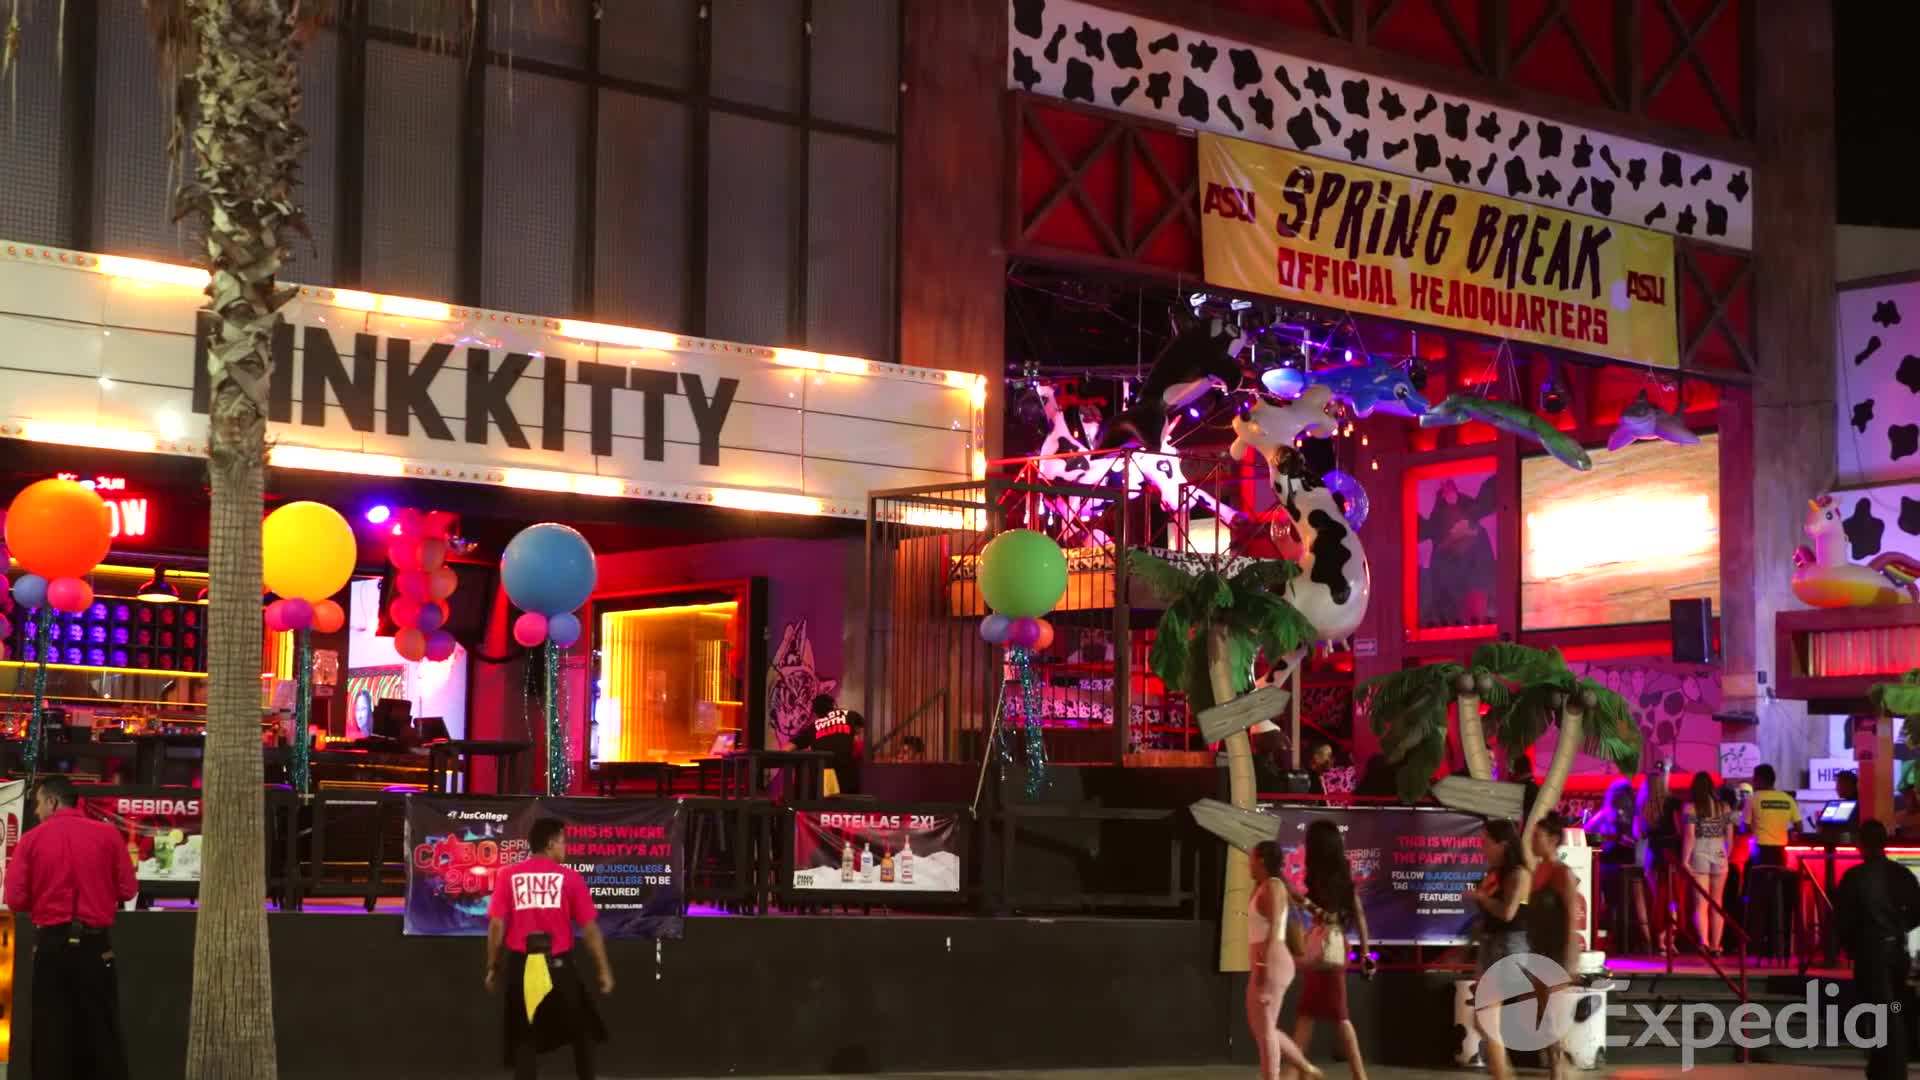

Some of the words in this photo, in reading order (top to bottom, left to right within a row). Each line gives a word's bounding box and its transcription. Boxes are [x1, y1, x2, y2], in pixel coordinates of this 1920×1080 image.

[1203, 182, 1256, 224] ASU
[1466, 204, 1612, 300] BREAK
[1277, 246, 1398, 306] OFFICIAL
[1410, 272, 1609, 345] HEADQUARTERS
[1626, 270, 1666, 305] ASU
[117, 798, 200, 816] BEBIDAS
[458, 811, 509, 822] JusCollege
[820, 814, 900, 830] BOTELLAS
[566, 825, 598, 839] THIS
[599, 825, 613, 839] IS
[614, 825, 666, 839] WHERE
[564, 843, 586, 856] HE
[514, 875, 560, 891] PINK
[644, 875, 656, 885] TO
[658, 875, 671, 885] BE
[1391, 871, 1425, 880] FOLLOW
[589, 887, 640, 897] FEATURED!
[1392, 882, 1409, 891] TAG
[515, 889, 559, 907] KITTY
